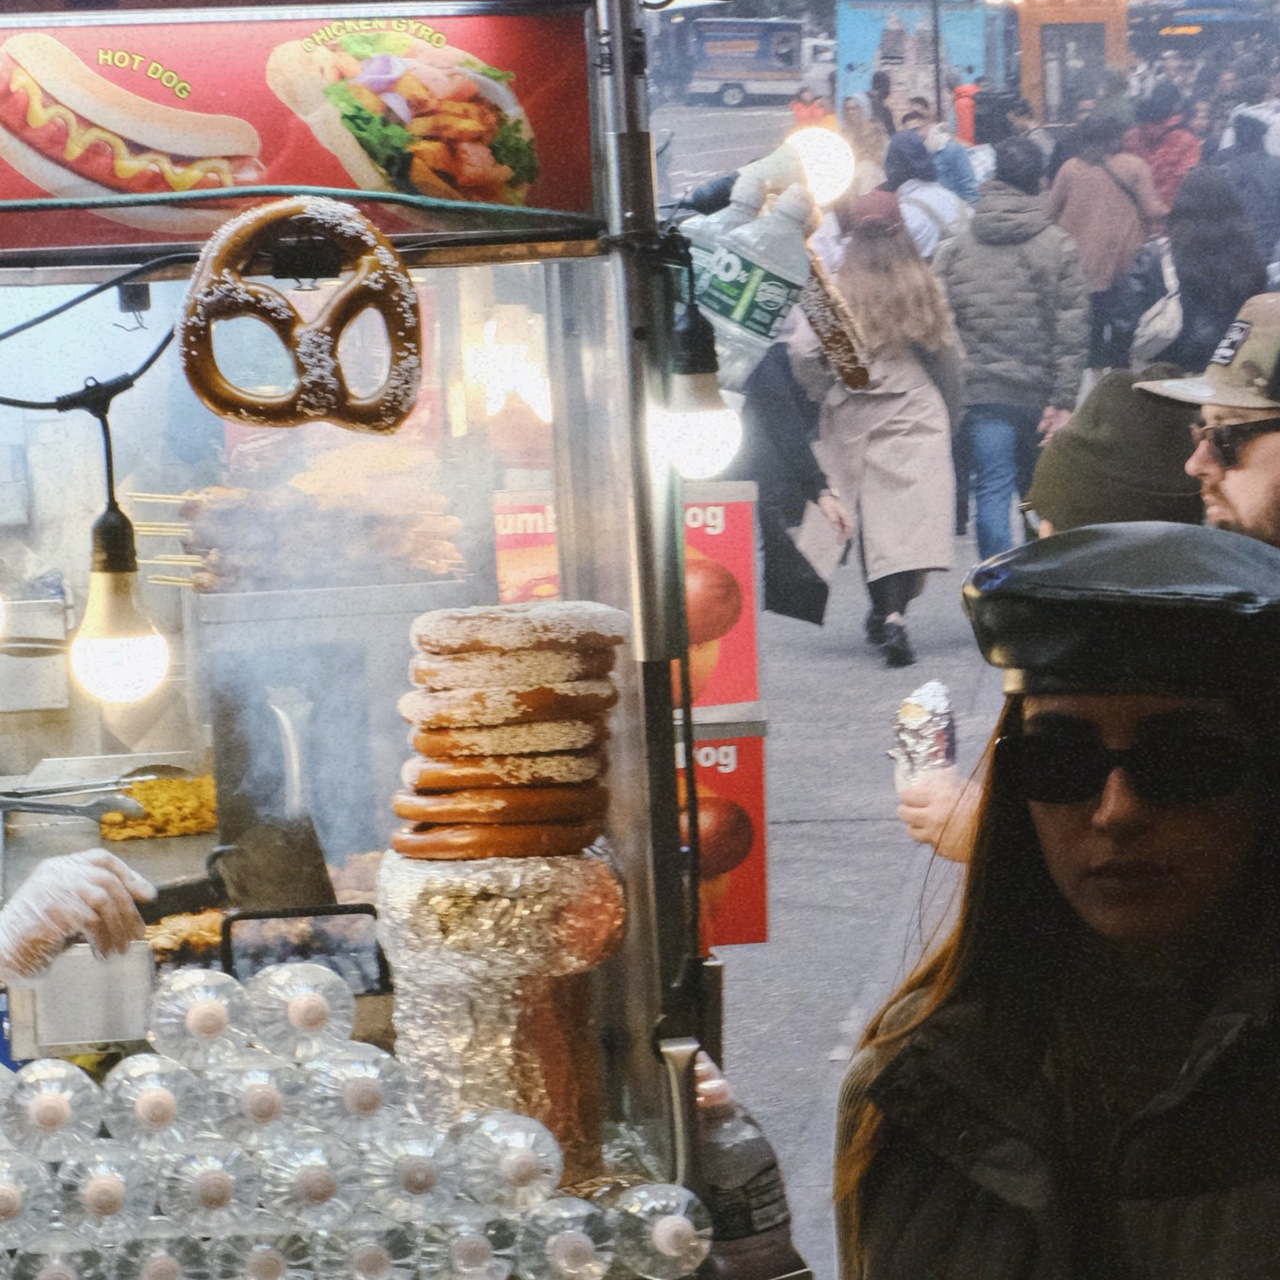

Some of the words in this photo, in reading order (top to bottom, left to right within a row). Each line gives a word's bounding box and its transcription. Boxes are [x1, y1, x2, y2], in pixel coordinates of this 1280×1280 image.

[301, 18, 388, 53] CHICKEN
[391, 18, 448, 48] GYRO
[97, 48, 145, 72] HOT
[145, 61, 192, 100] DOG
[683, 505, 725, 535] og
